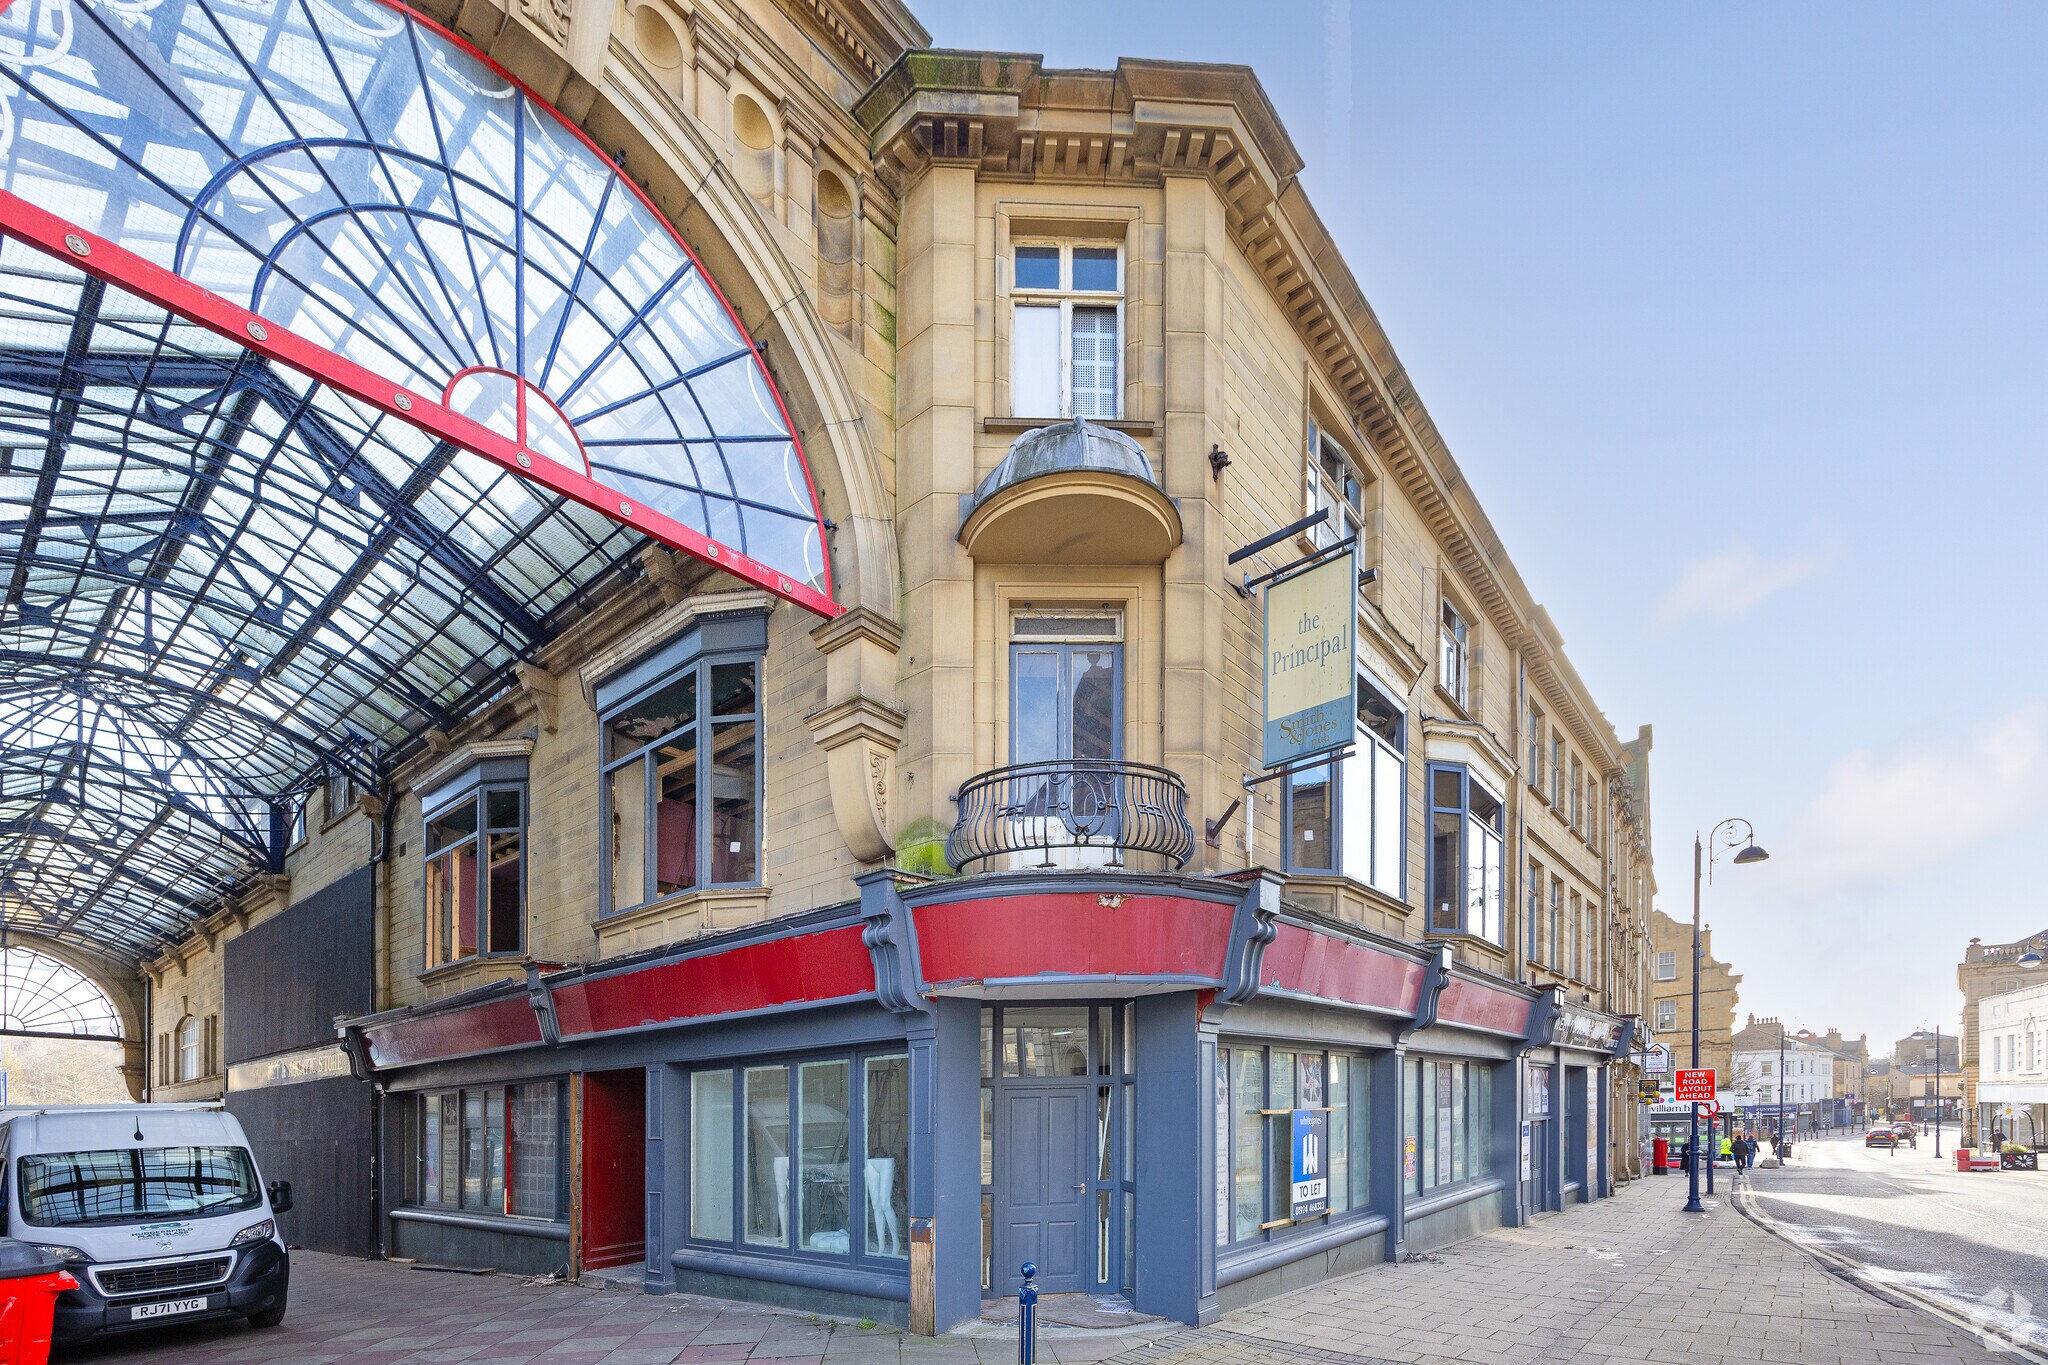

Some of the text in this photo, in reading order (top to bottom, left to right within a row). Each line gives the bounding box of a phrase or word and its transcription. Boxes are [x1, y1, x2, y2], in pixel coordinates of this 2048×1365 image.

[1298, 612, 1320, 635] the
[1272, 624, 1348, 676] Principal
[1280, 709, 1325, 739] Smith
[1311, 732, 1330, 750] pub
[318, 1053, 343, 1073] STORE
[1299, 1183, 1321, 1198] TO LET
[131, 1227, 193, 1238] HUDDERSFIELD
[140, 1299, 199, 1317] RJ71 YYG
